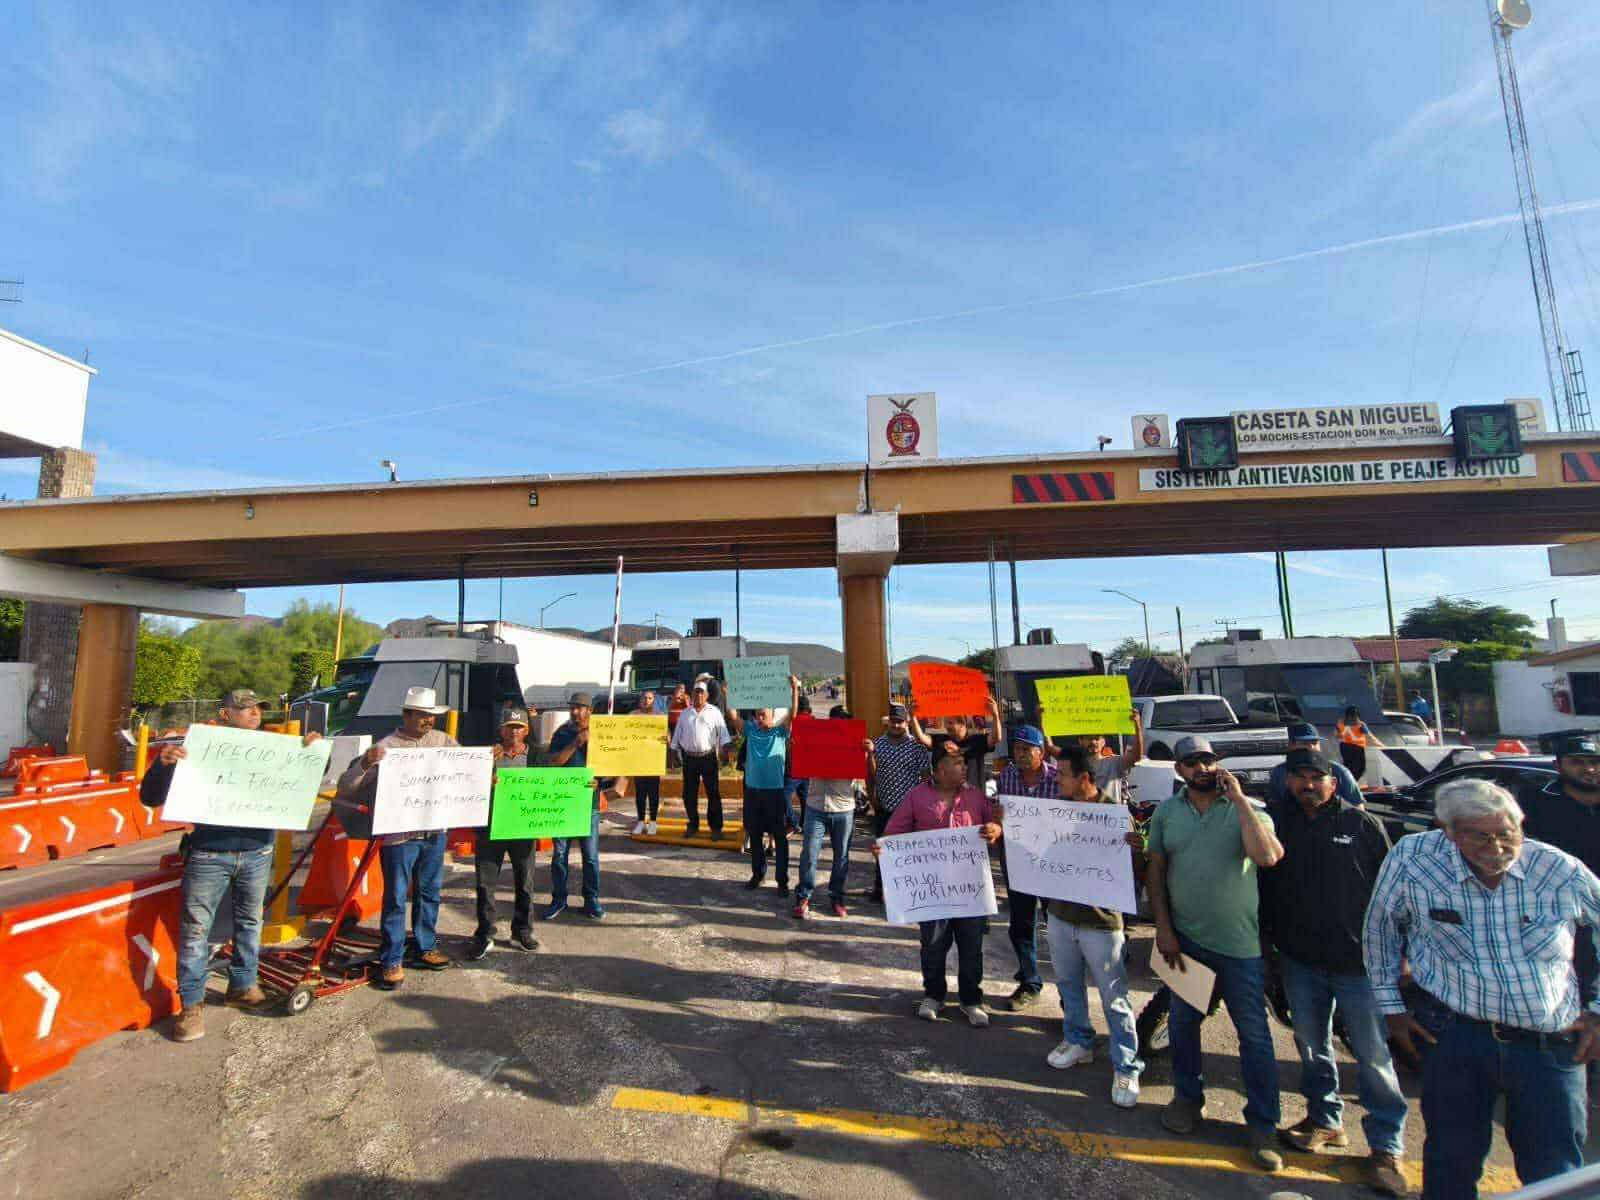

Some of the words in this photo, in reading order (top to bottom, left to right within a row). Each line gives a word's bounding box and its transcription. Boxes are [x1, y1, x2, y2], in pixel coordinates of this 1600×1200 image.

[1237, 411, 1309, 431] CASETA
[1316, 408, 1353, 427] SAN
[1360, 404, 1435, 425] MIGUEL
[1238, 434, 1256, 443] LOS
[1355, 425, 1376, 438] DON
[1155, 470, 1232, 488] SISTEMA
[1238, 463, 1354, 486] ANTIEVASION
[1361, 463, 1385, 480] DE
[1391, 460, 1447, 479] PEAJE
[1454, 457, 1520, 477] ACTIVO
[201, 738, 274, 762] PRECIO
[895, 852, 947, 868] CENTRO
[894, 872, 943, 890] FRIJOL
